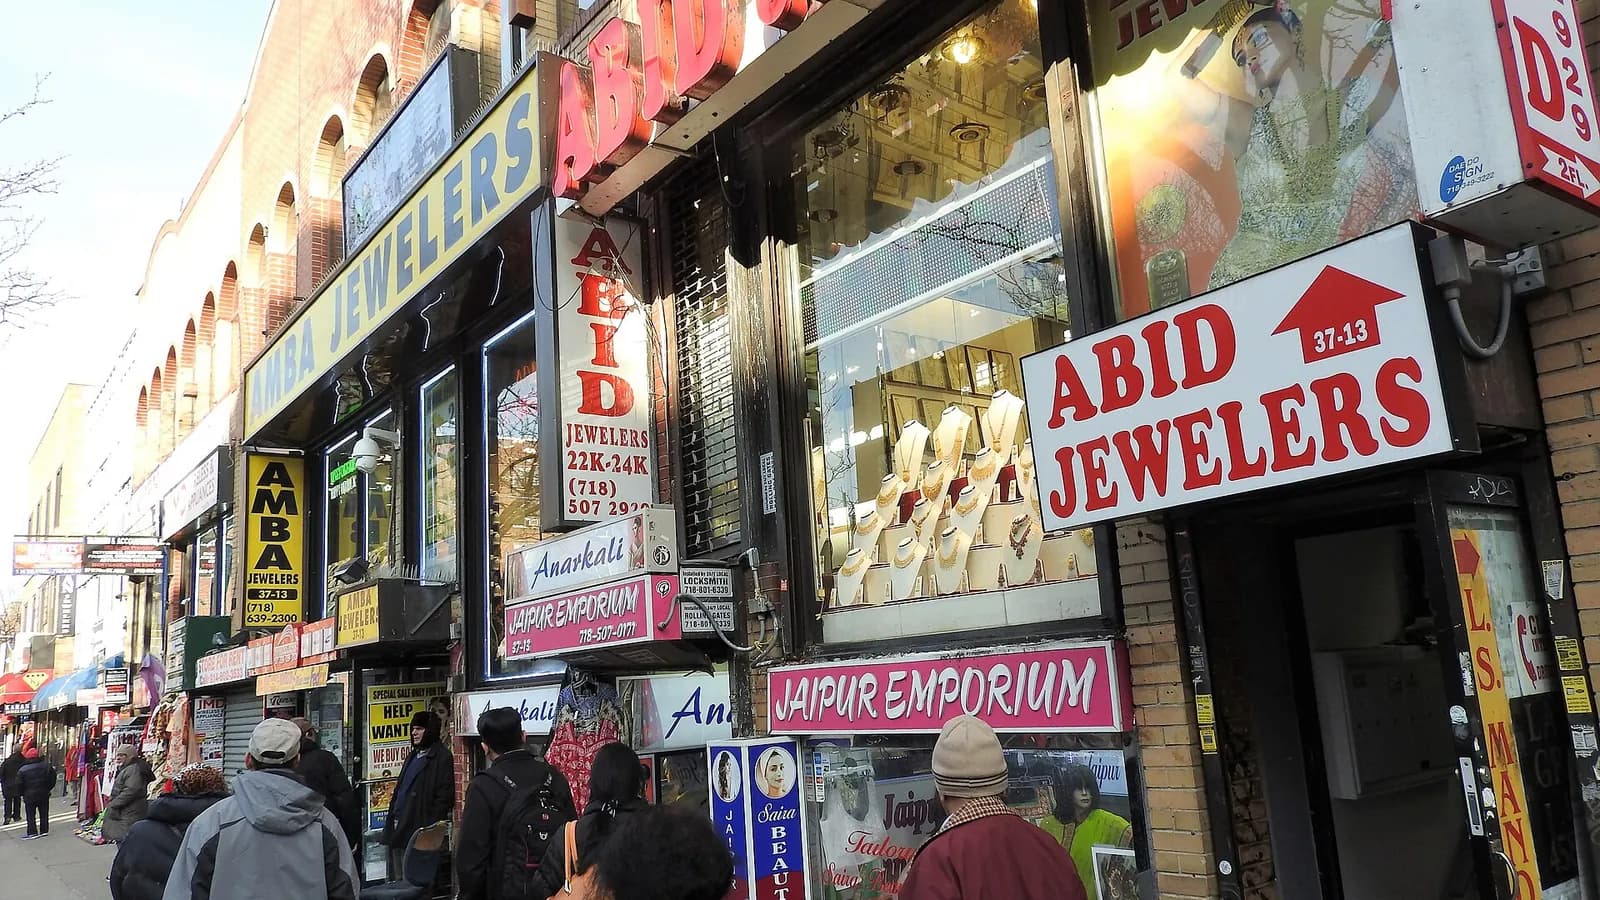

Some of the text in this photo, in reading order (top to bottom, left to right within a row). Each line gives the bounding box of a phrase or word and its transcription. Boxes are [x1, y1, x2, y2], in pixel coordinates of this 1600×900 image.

[1454, 163, 1483, 182] SIGN
[250, 92, 533, 425] AMBA JEWELERS
[571, 227, 633, 418] ABID
[1313, 319, 1369, 353] 37-13
[1047, 304, 1236, 429] ABID
[565, 423, 649, 448] JEWELERS
[1049, 356, 1431, 519] JEWELERS
[567, 450, 649, 475] 22K-24K
[568, 477, 617, 498] (718)
[251, 462, 299, 570] AMBA
[569, 499, 600, 516] 507
[530, 536, 624, 590] Anarkali
[248, 573, 299, 585] JEWELERS
[684, 577, 728, 585] LOCKSMITH
[258, 590, 288, 599] 37-13
[247, 602, 274, 613] (718)
[509, 584, 640, 635] JAIPUR EMPORIUM
[247, 614, 298, 623] 639-2300
[511, 639, 531, 653] 37-13
[373, 688, 396, 700] SPECIAL
[775, 657, 1097, 722] JAIPUR EMPORIUM
[383, 703, 413, 719] HELP
[373, 749, 384, 763] WE
[385, 747, 400, 762] BUY
[757, 803, 797, 824] Saira
